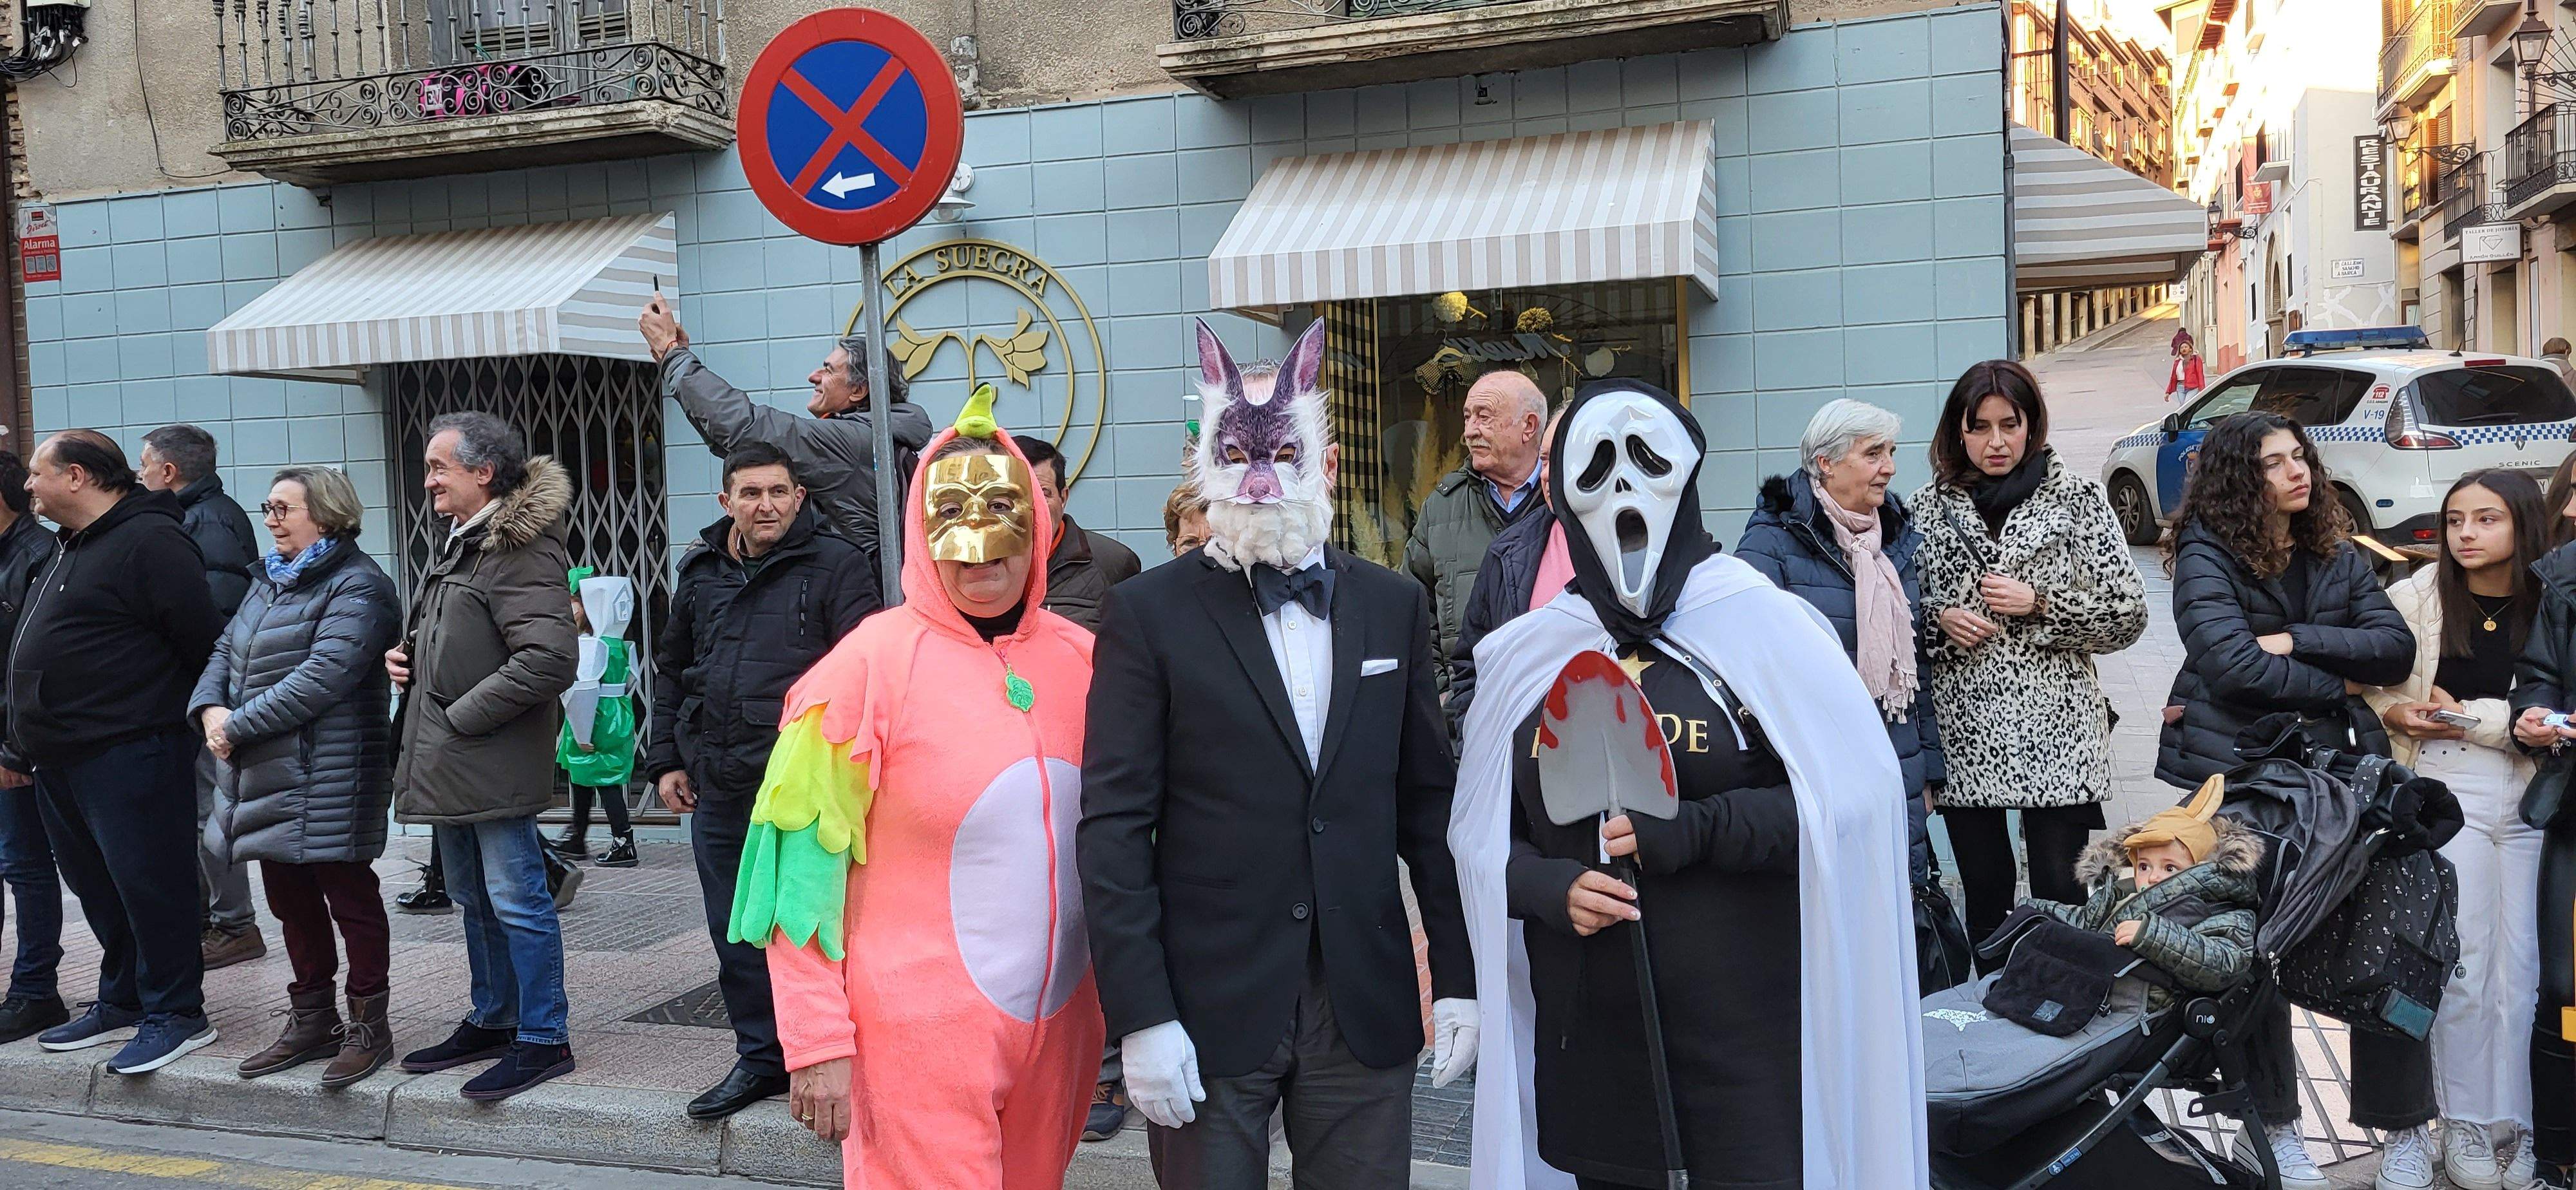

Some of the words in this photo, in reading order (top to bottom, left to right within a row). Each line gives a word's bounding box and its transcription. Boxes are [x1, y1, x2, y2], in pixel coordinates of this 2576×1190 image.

[2359, 138, 2382, 226] RESTAURANTE
[24, 239, 56, 250] Alarma
[885, 265, 923, 299] LA
[934, 247, 1049, 298] SUEGRA
[2364, 409, 2385, 420] V-19
